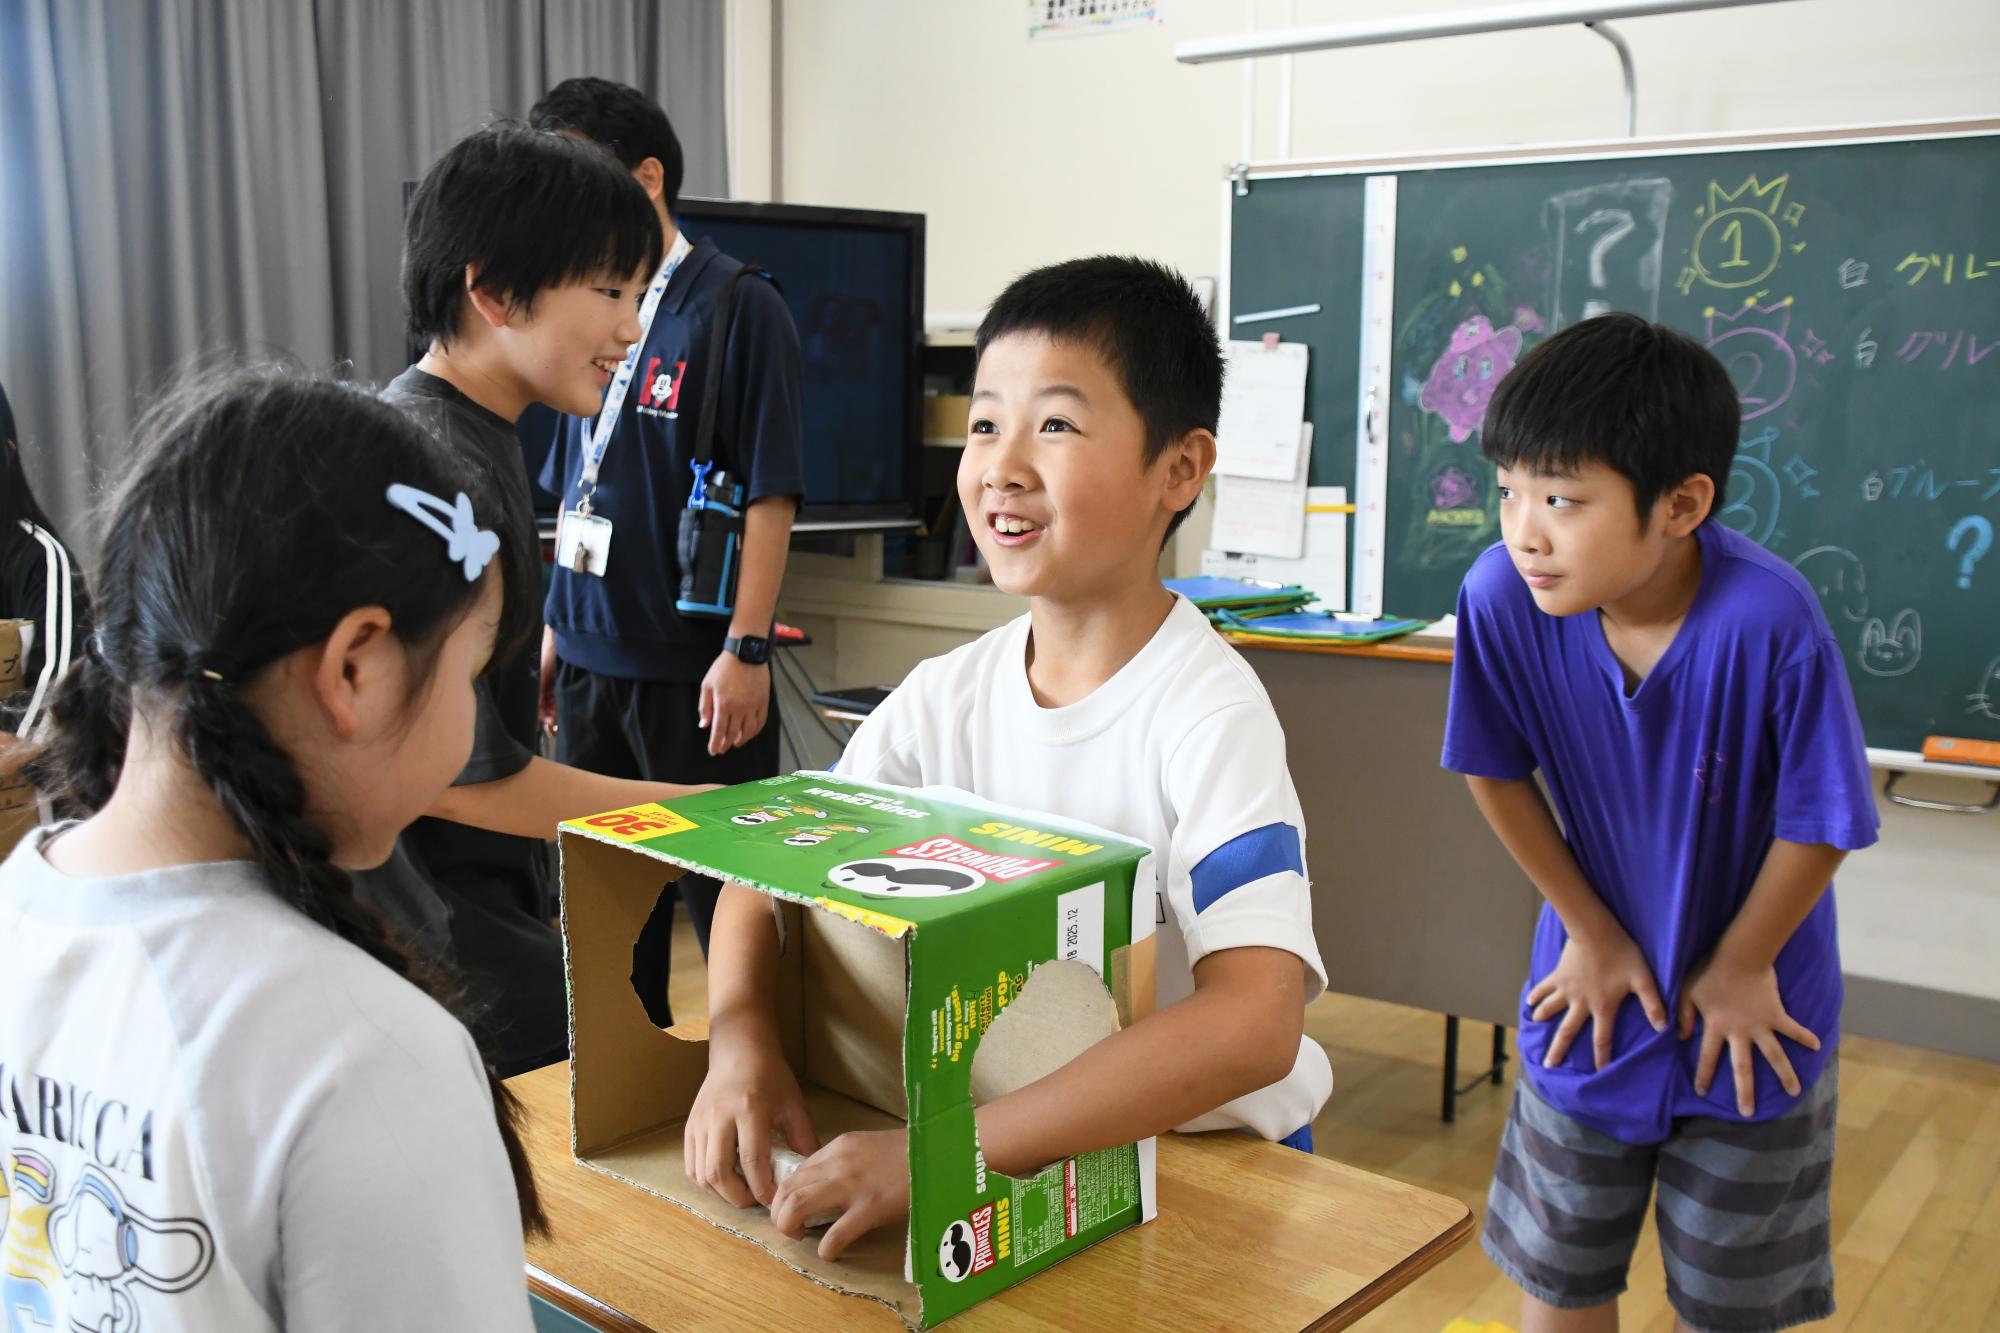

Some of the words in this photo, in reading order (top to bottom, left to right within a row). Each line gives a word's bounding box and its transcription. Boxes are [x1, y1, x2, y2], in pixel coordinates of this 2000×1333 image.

[802, 787, 874, 806] CREAM
[869, 802, 931, 819] SOUR
[585, 813, 668, 836] 30
[969, 822, 1104, 856] MINIS
[895, 838, 1051, 879] PRINGLES
[972, 1206, 994, 1273] PRINGLES
[996, 1197, 1011, 1260] MINIS
